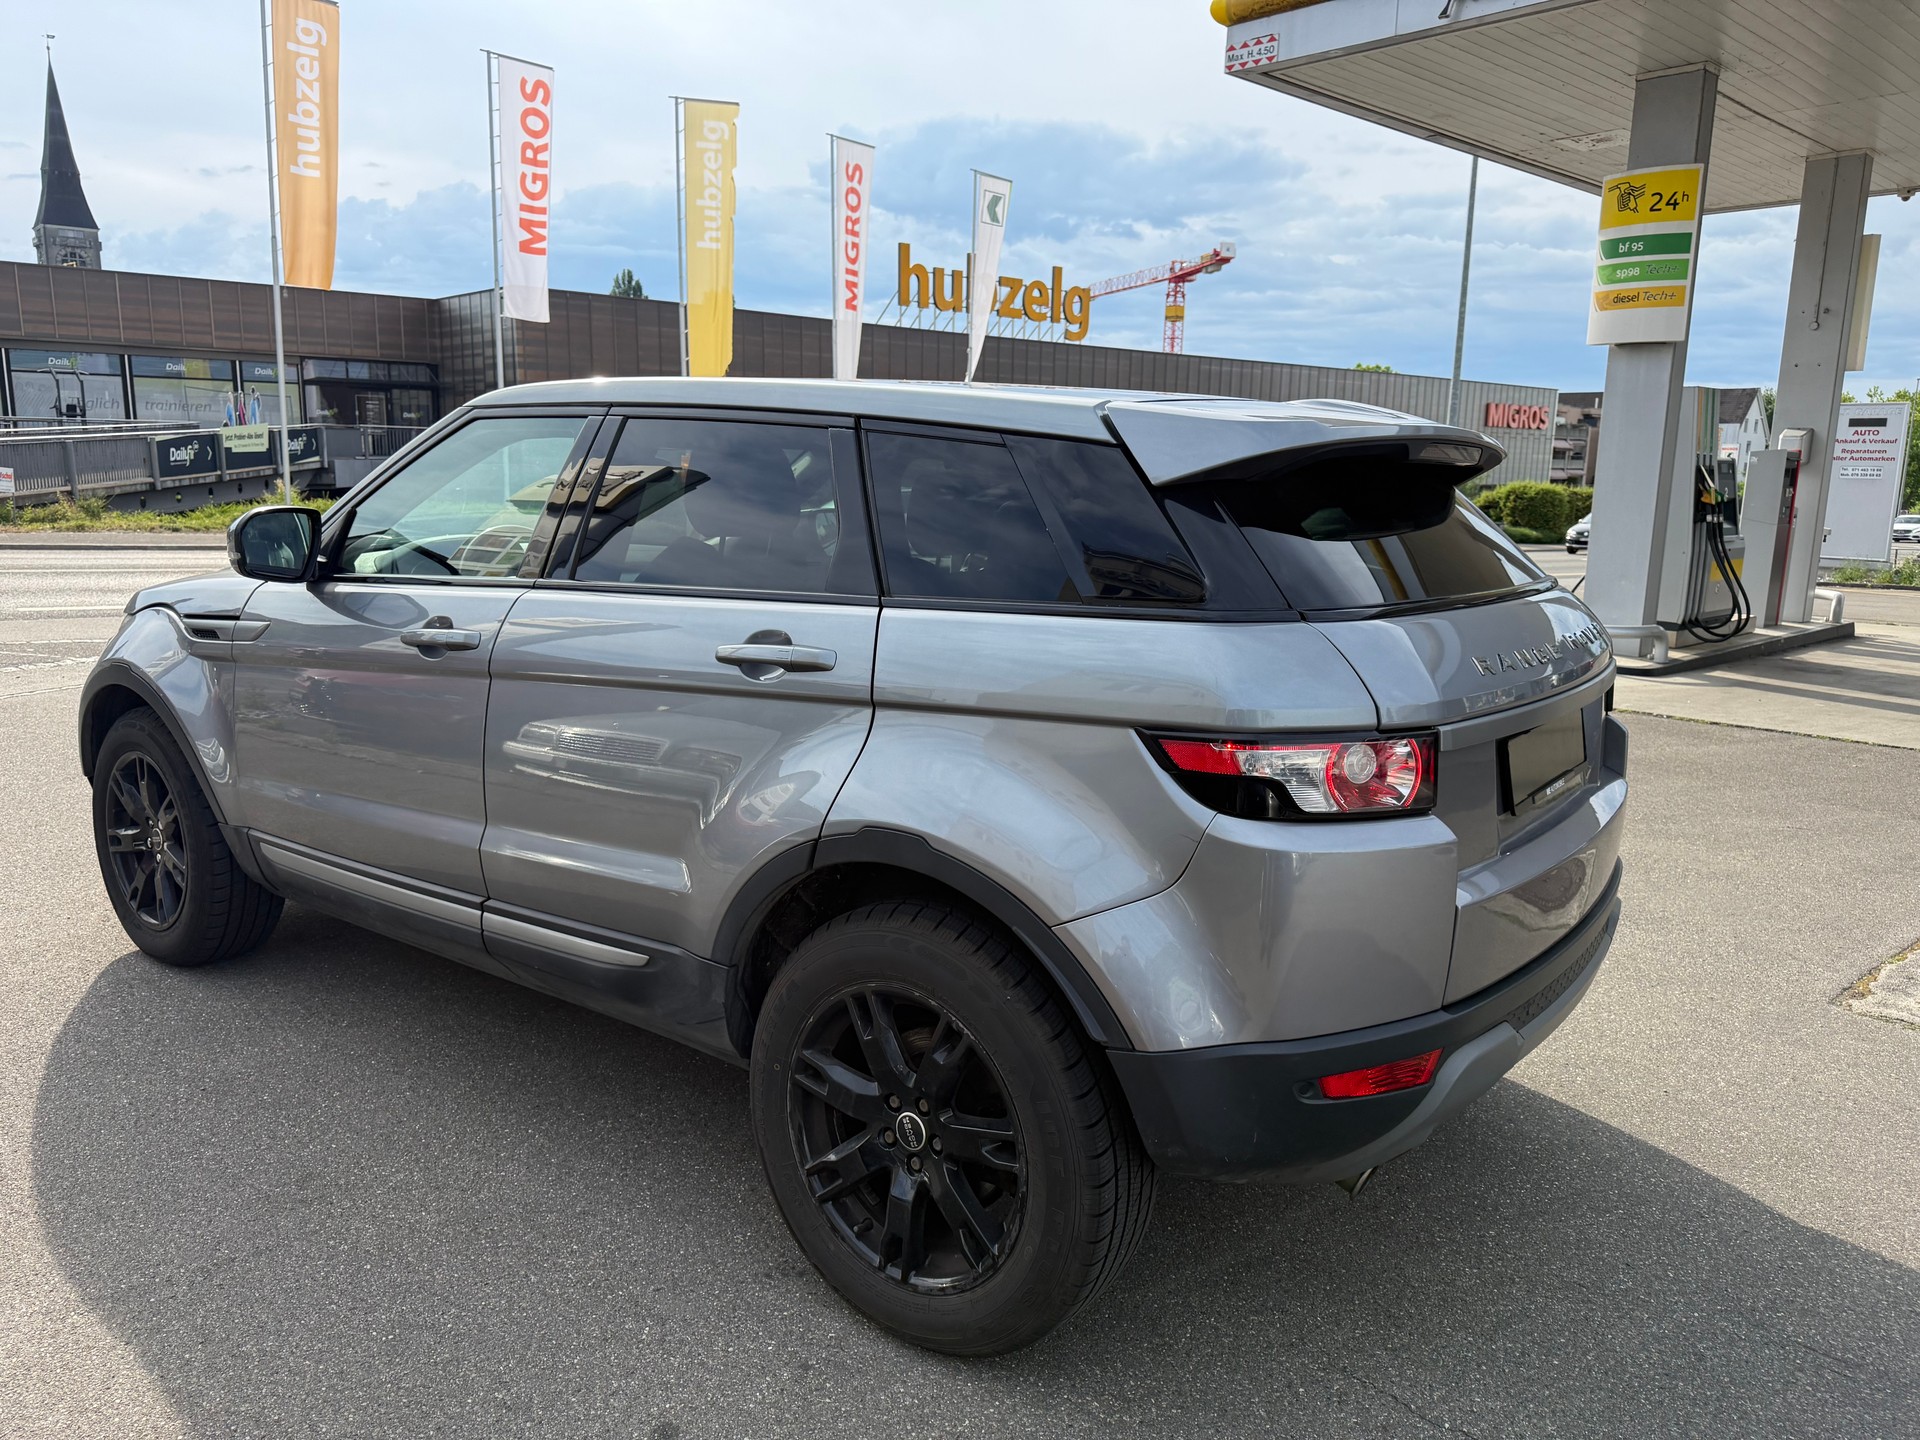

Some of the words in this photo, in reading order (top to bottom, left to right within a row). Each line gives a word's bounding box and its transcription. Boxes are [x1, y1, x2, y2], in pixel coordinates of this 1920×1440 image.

[1227, 53, 1244, 63] Max
[286, 17, 328, 178] hubzelg
[518, 76, 551, 256] MIGROS
[695, 119, 730, 249] hubzelg
[1648, 190, 1690, 213] 24h
[844, 161, 864, 312] MIGROS
[1618, 241, 1630, 253] bf
[1631, 241, 1644, 252] 95
[1615, 266, 1641, 280] sp98
[1645, 263, 1680, 275] Tech+
[1612, 291, 1640, 304] diesel
[1642, 289, 1677, 302] Tech+
[1485, 402, 1549, 430] MIGROS
[1470, 642, 1564, 676] RANGE
[1561, 622, 1604, 650] ROVE
